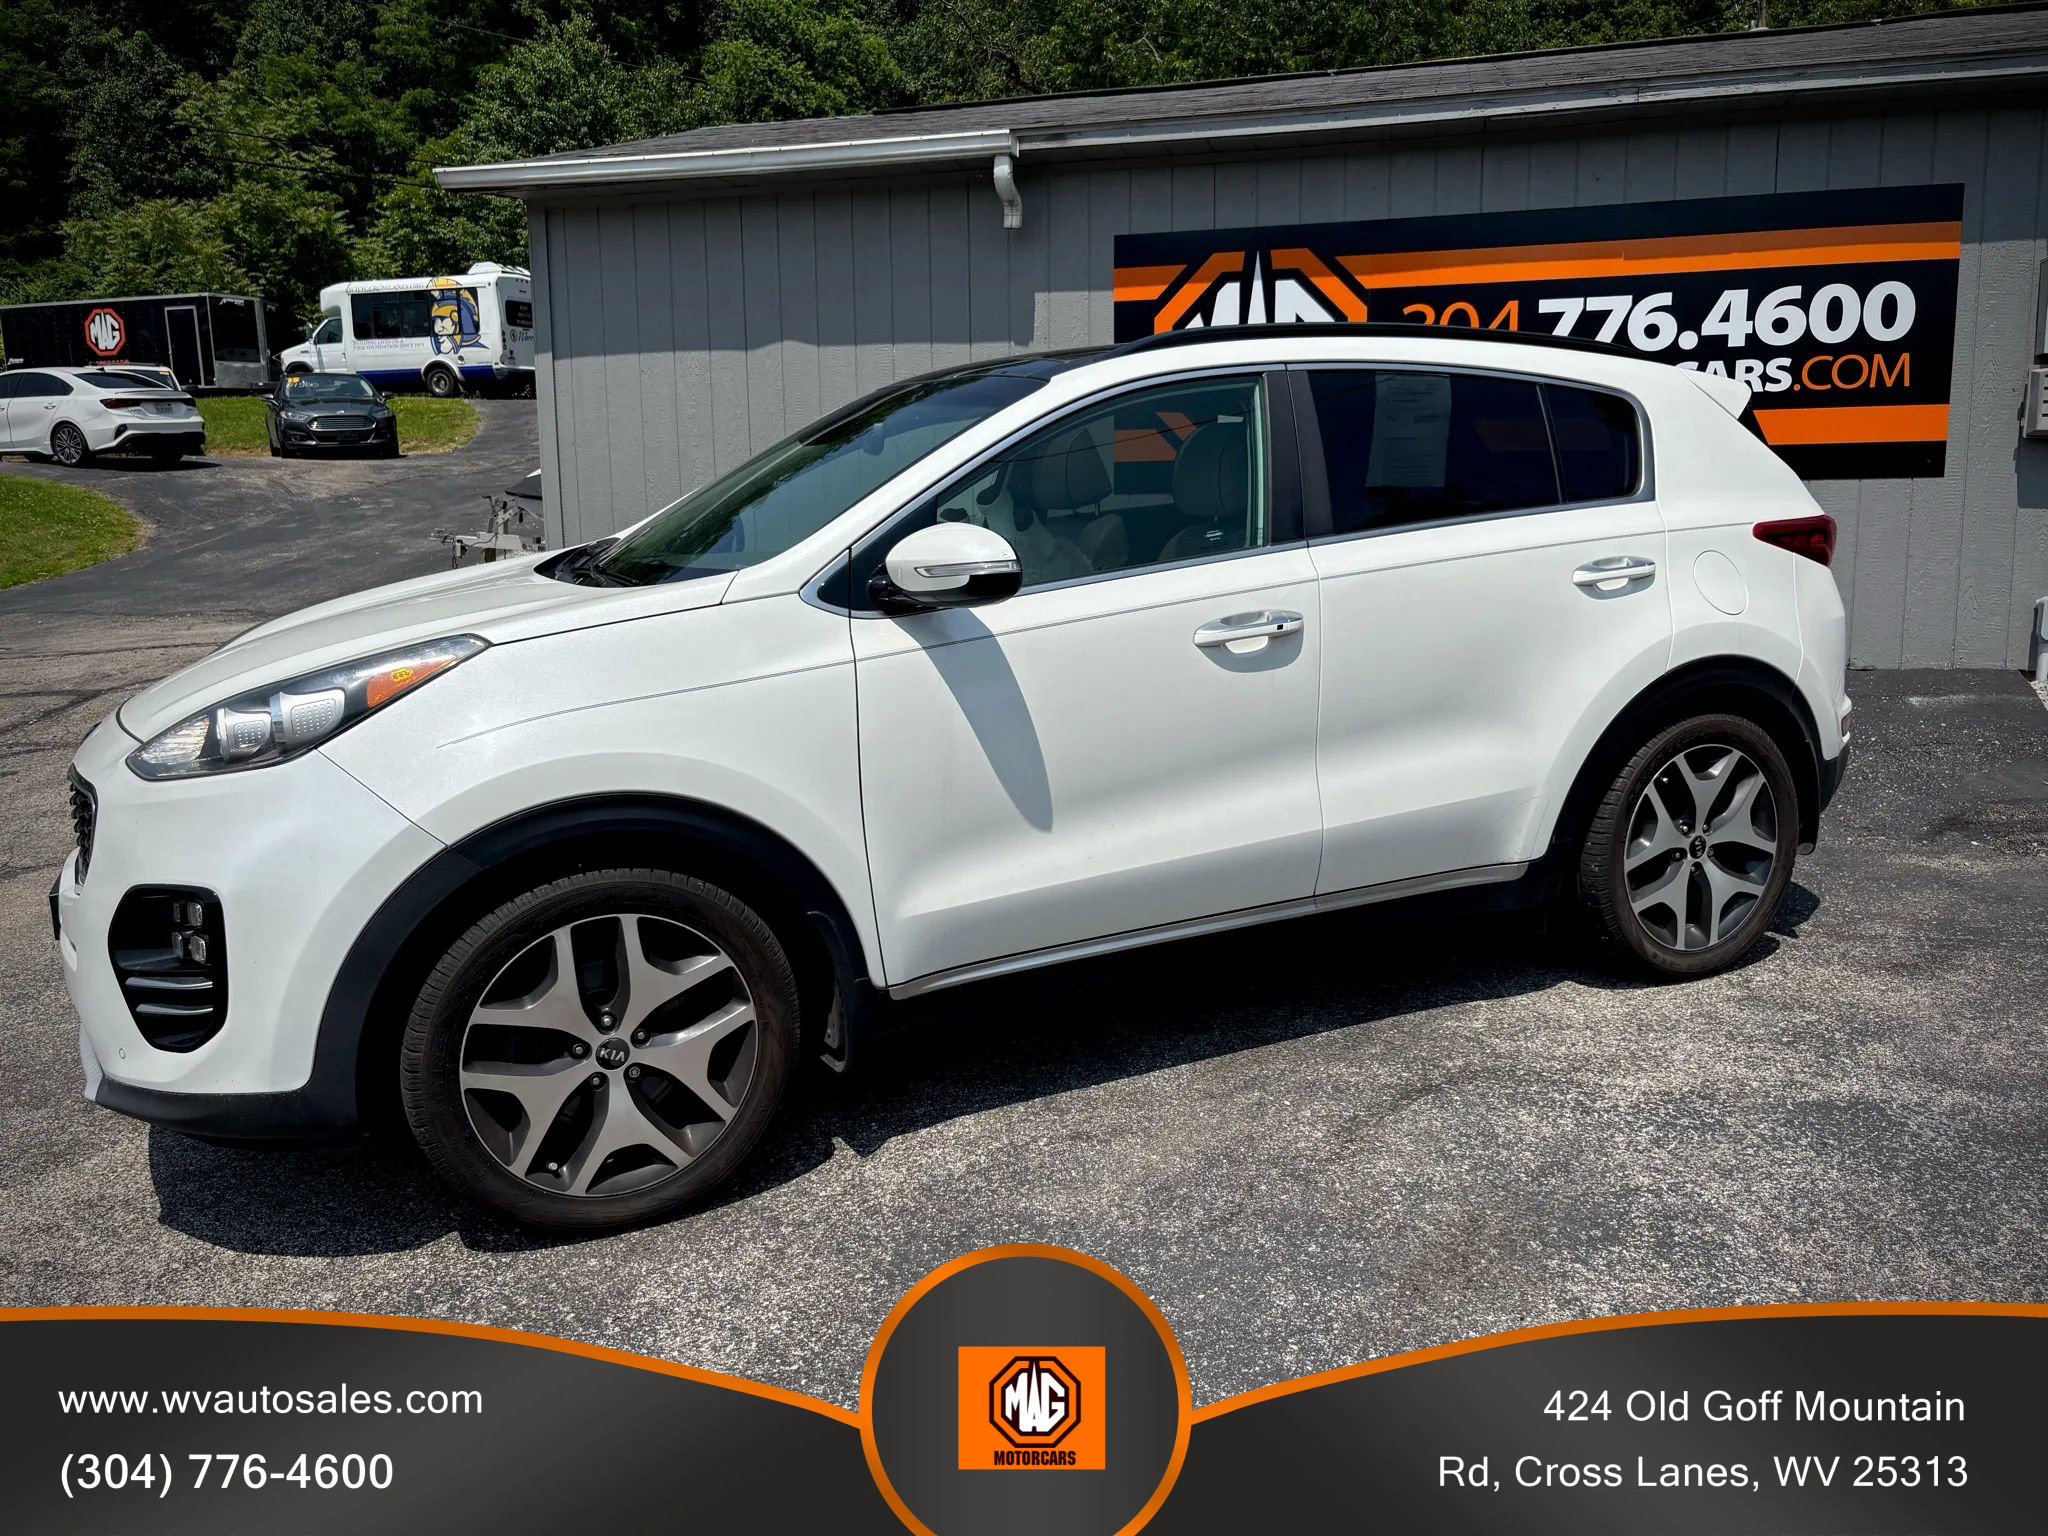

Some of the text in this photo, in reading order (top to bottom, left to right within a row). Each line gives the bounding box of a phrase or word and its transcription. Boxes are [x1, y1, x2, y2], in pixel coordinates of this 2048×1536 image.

[90, 310, 120, 350] MAG
[1538, 281, 1916, 352] 776.4600
[600, 1047, 625, 1062] KIA
